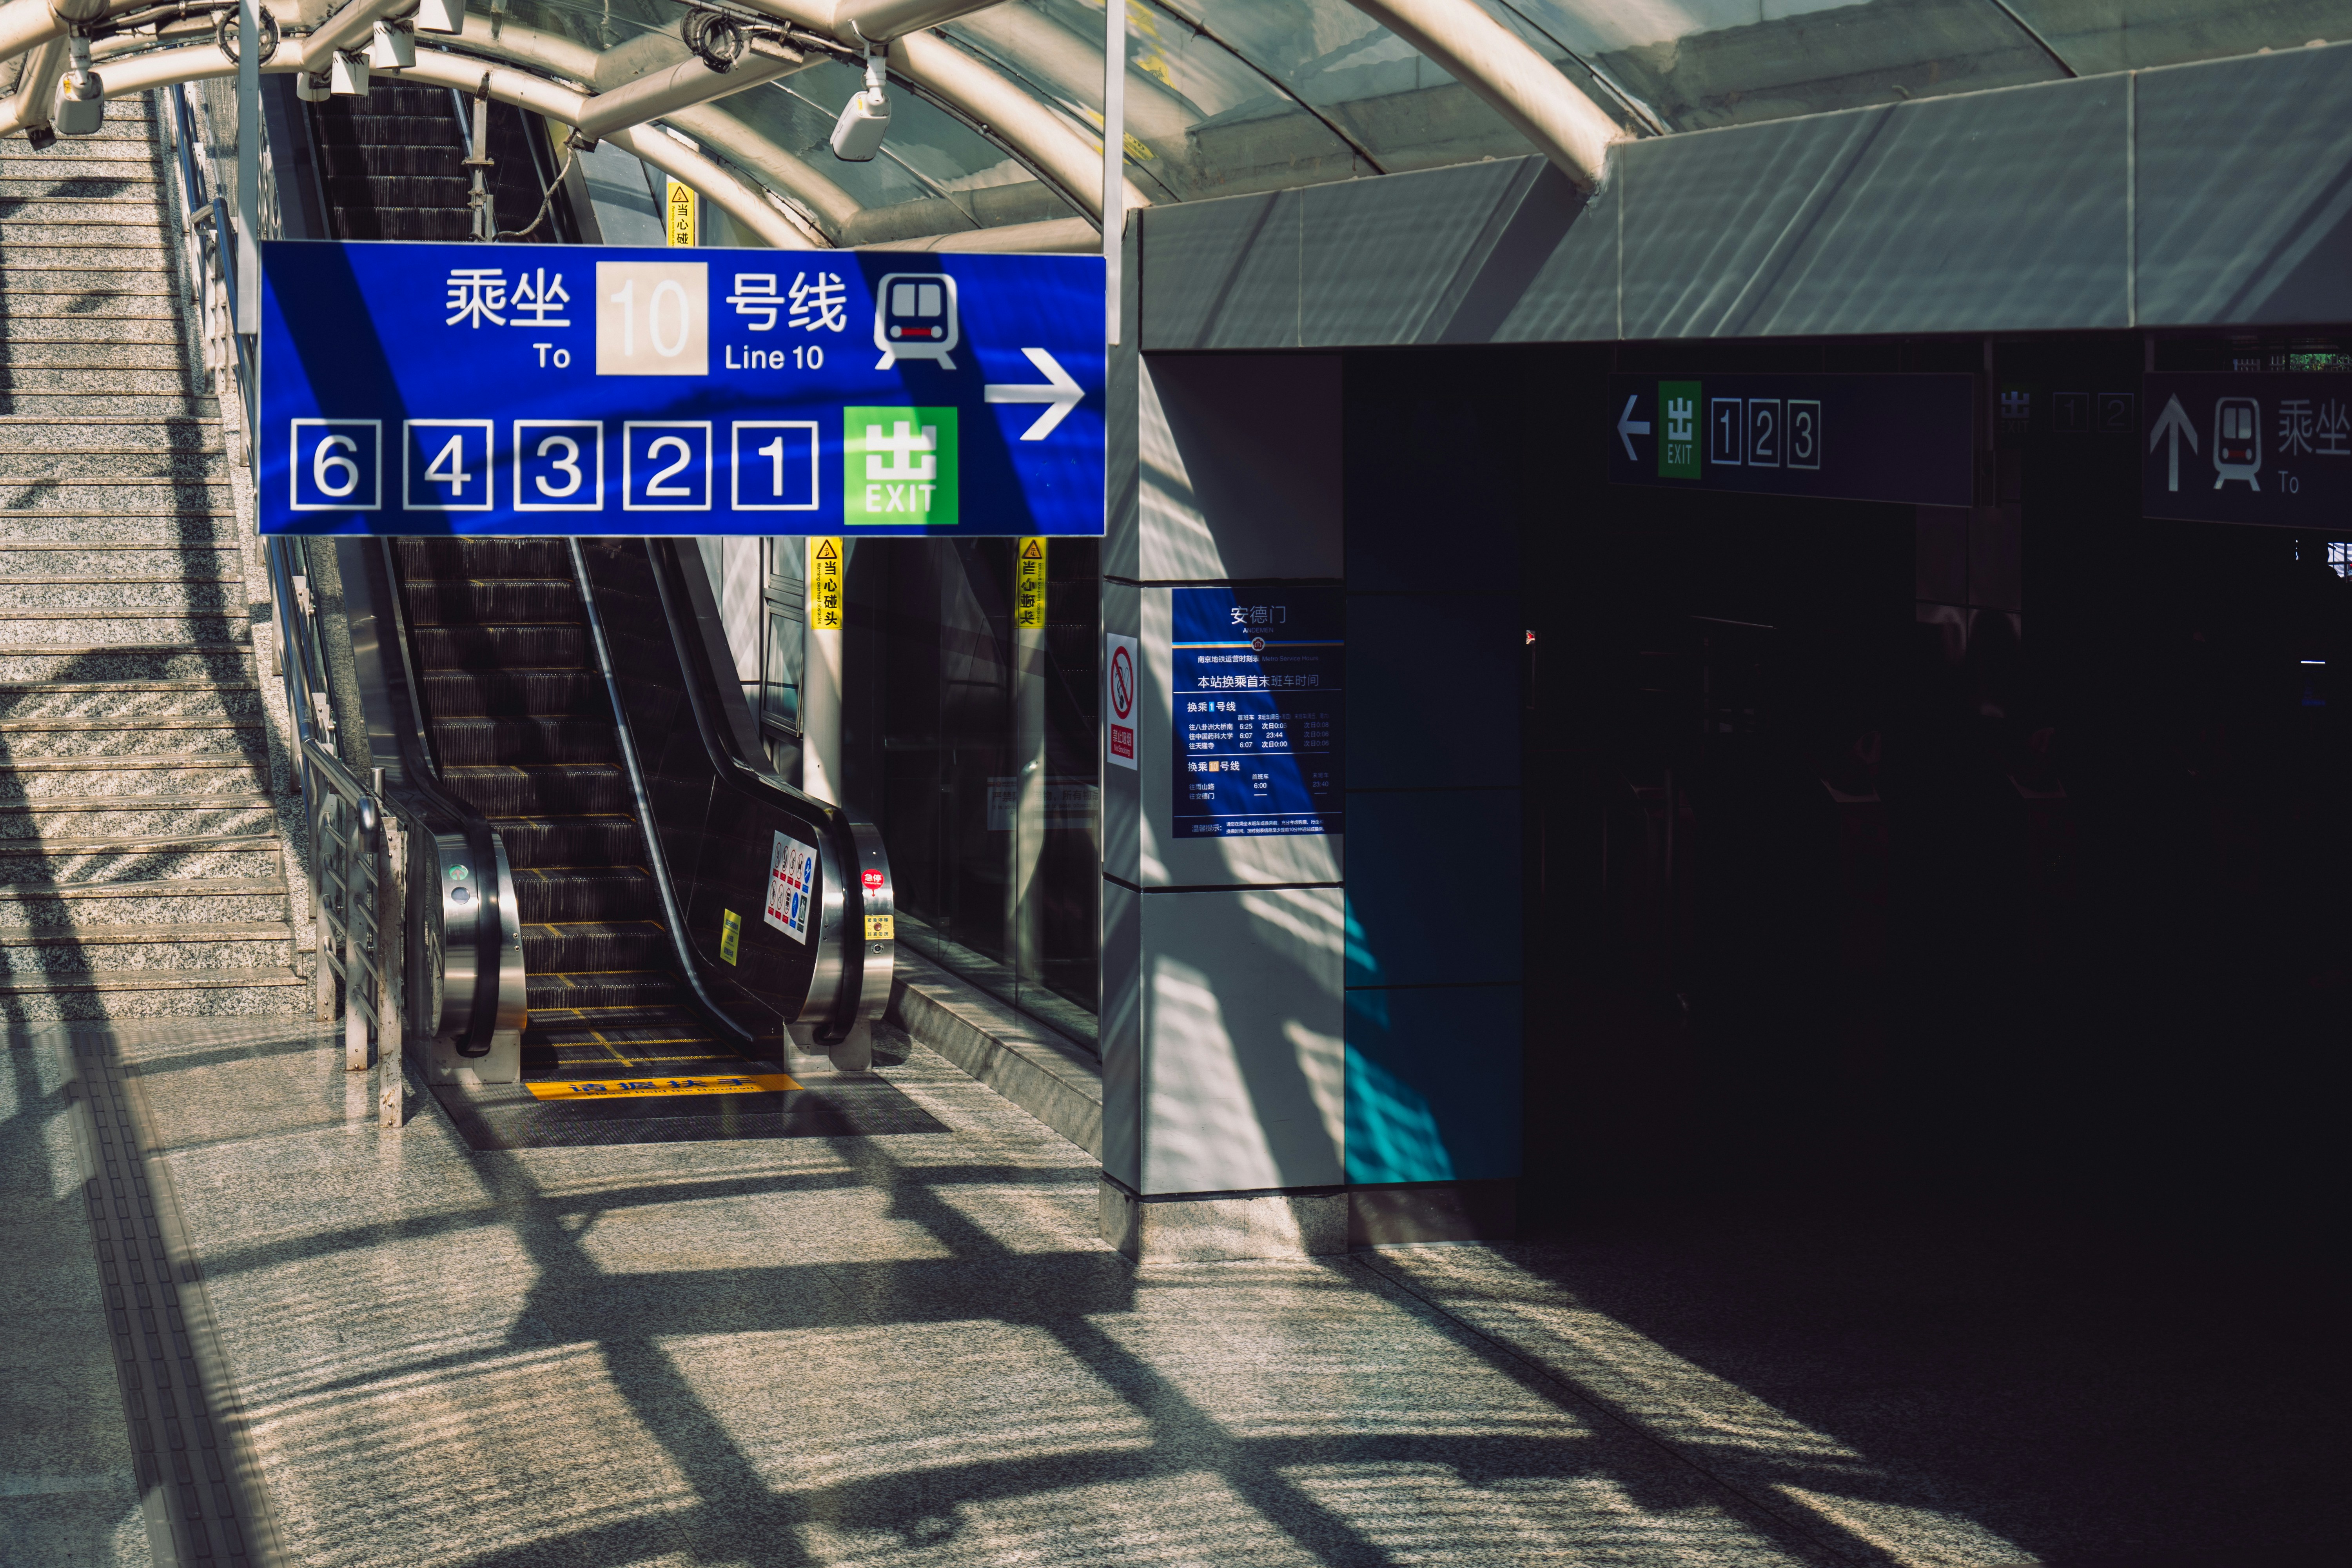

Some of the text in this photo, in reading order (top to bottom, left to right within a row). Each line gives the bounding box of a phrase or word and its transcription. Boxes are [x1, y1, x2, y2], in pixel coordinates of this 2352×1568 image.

[677, 204, 688, 246] 当心碰
[445, 267, 847, 358] 乘坐 10 号线
[532, 343, 823, 369] To Line 10
[2064, 399, 2125, 426] 1 2
[1718, 406, 1813, 458] 1 2 3
[2278, 397, 2351, 456] 乘坐
[312, 433, 784, 499] 6 4 3 2 1
[1667, 444, 1693, 465] EXIT
[2278, 471, 2299, 494] To
[865, 483, 936, 512] EXIT
[824, 561, 837, 626] 当心碰头
[1230, 605, 1286, 625] 安德门
[1197, 655, 1259, 663] 南京地铁运营时刻表
[1197, 674, 1319, 688] 本站换乘首末班车时间
[1112, 728, 1131, 747] 禁止吸烟
[1114, 744, 1130, 757] No Smoking
[864, 873, 882, 882] 急停
[568, 1077, 757, 1093] 请握扶手
